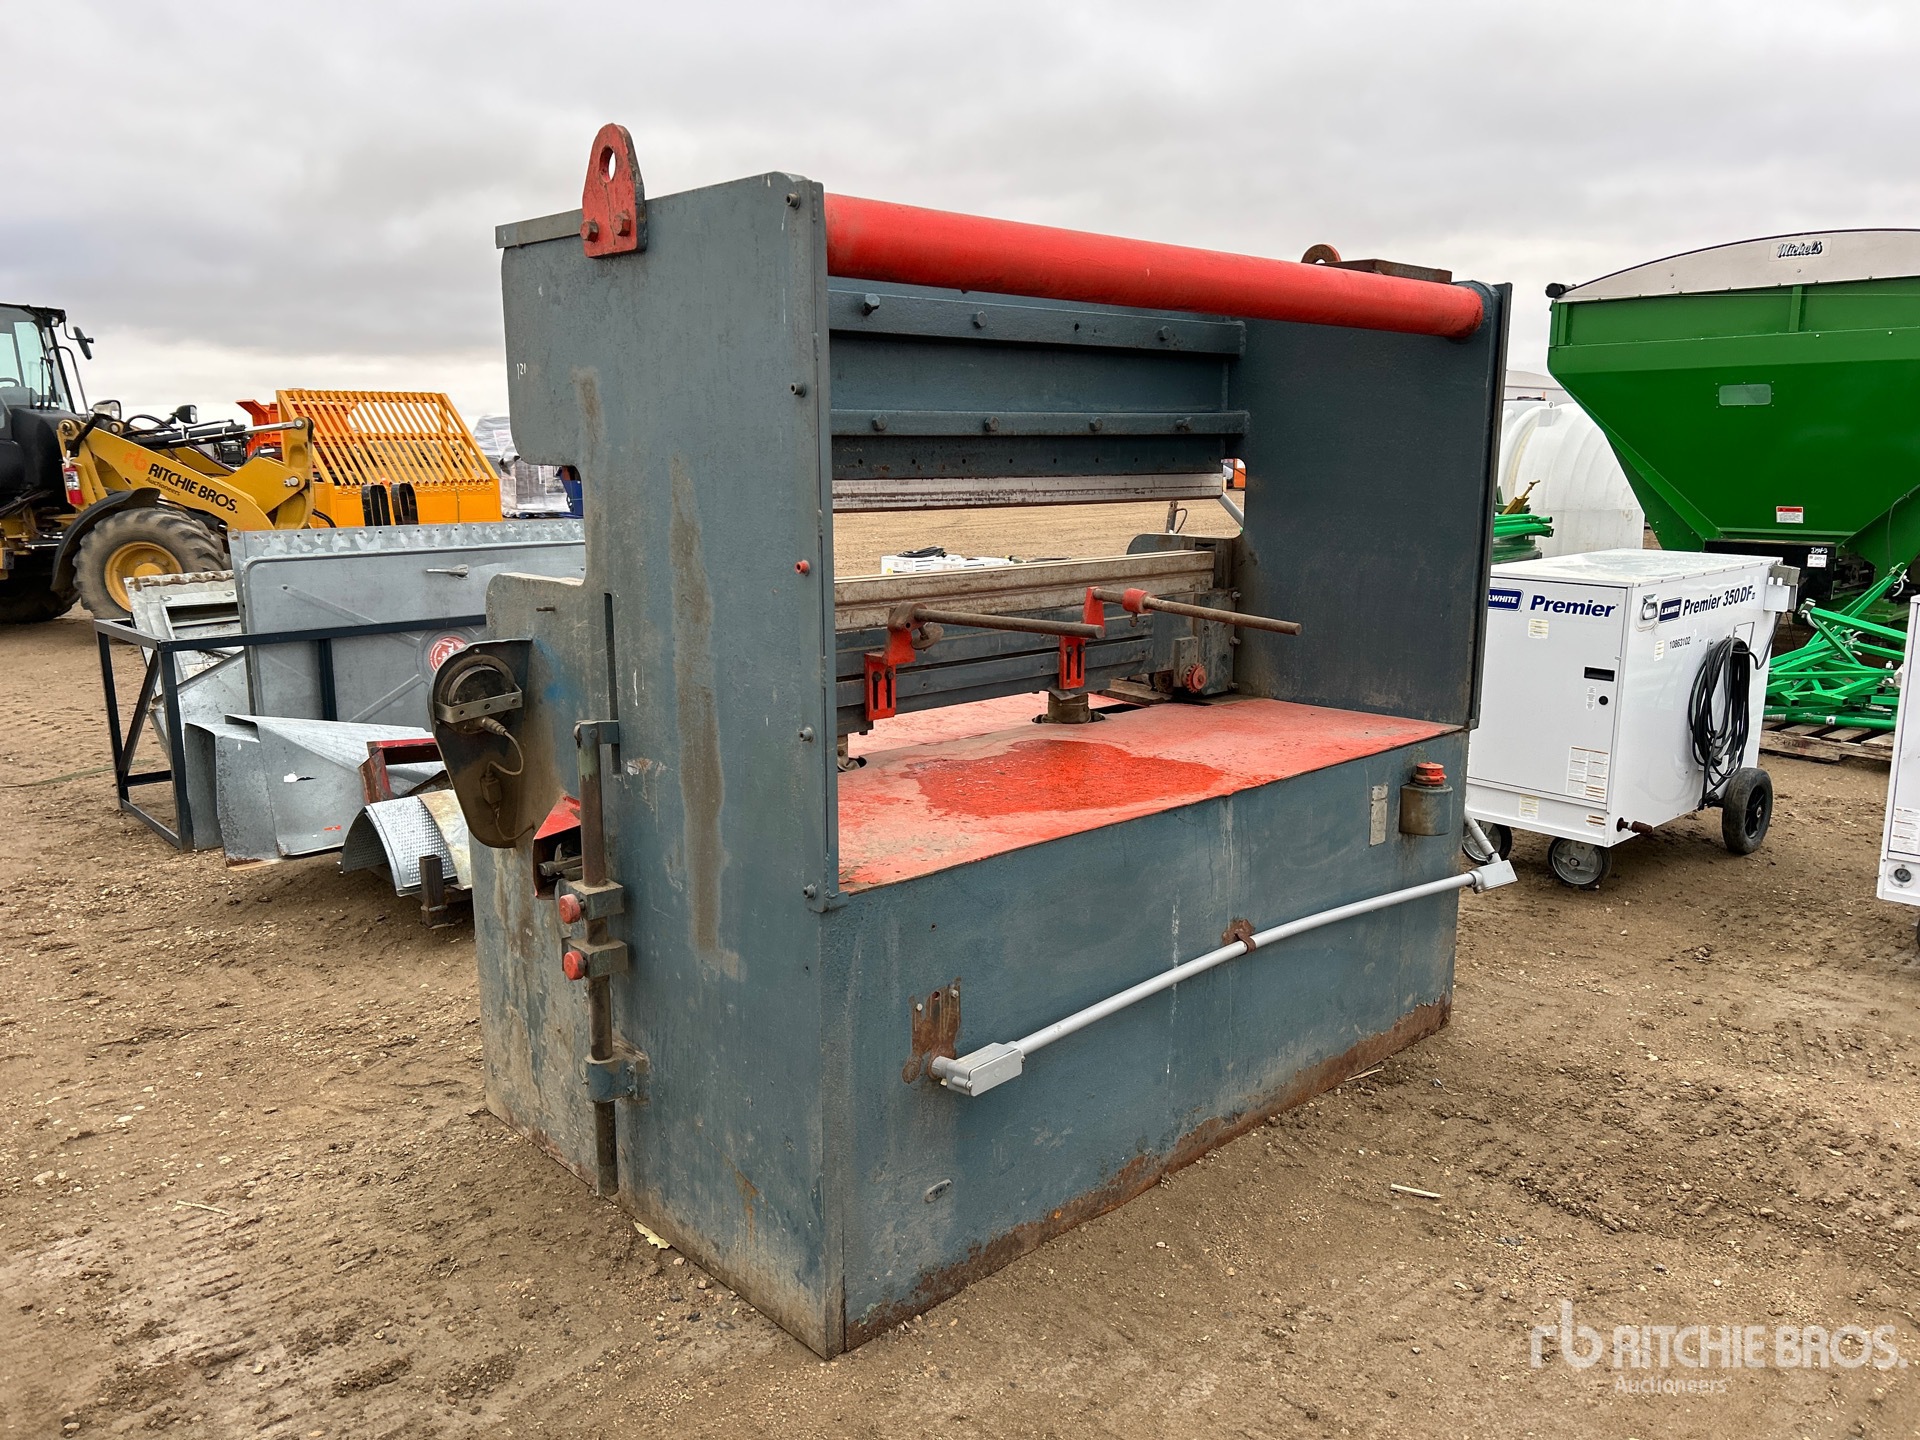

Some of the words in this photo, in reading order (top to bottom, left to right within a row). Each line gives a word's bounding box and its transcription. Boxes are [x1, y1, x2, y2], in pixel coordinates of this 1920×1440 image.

[1777, 240, 1823, 258] Michel's
[145, 476, 181, 496] Auctioneers
[148, 463, 199, 495] RITCHIE
[197, 485, 239, 514] BROS.
[1530, 594, 1616, 617] Premier
[1682, 594, 1722, 616] Premier
